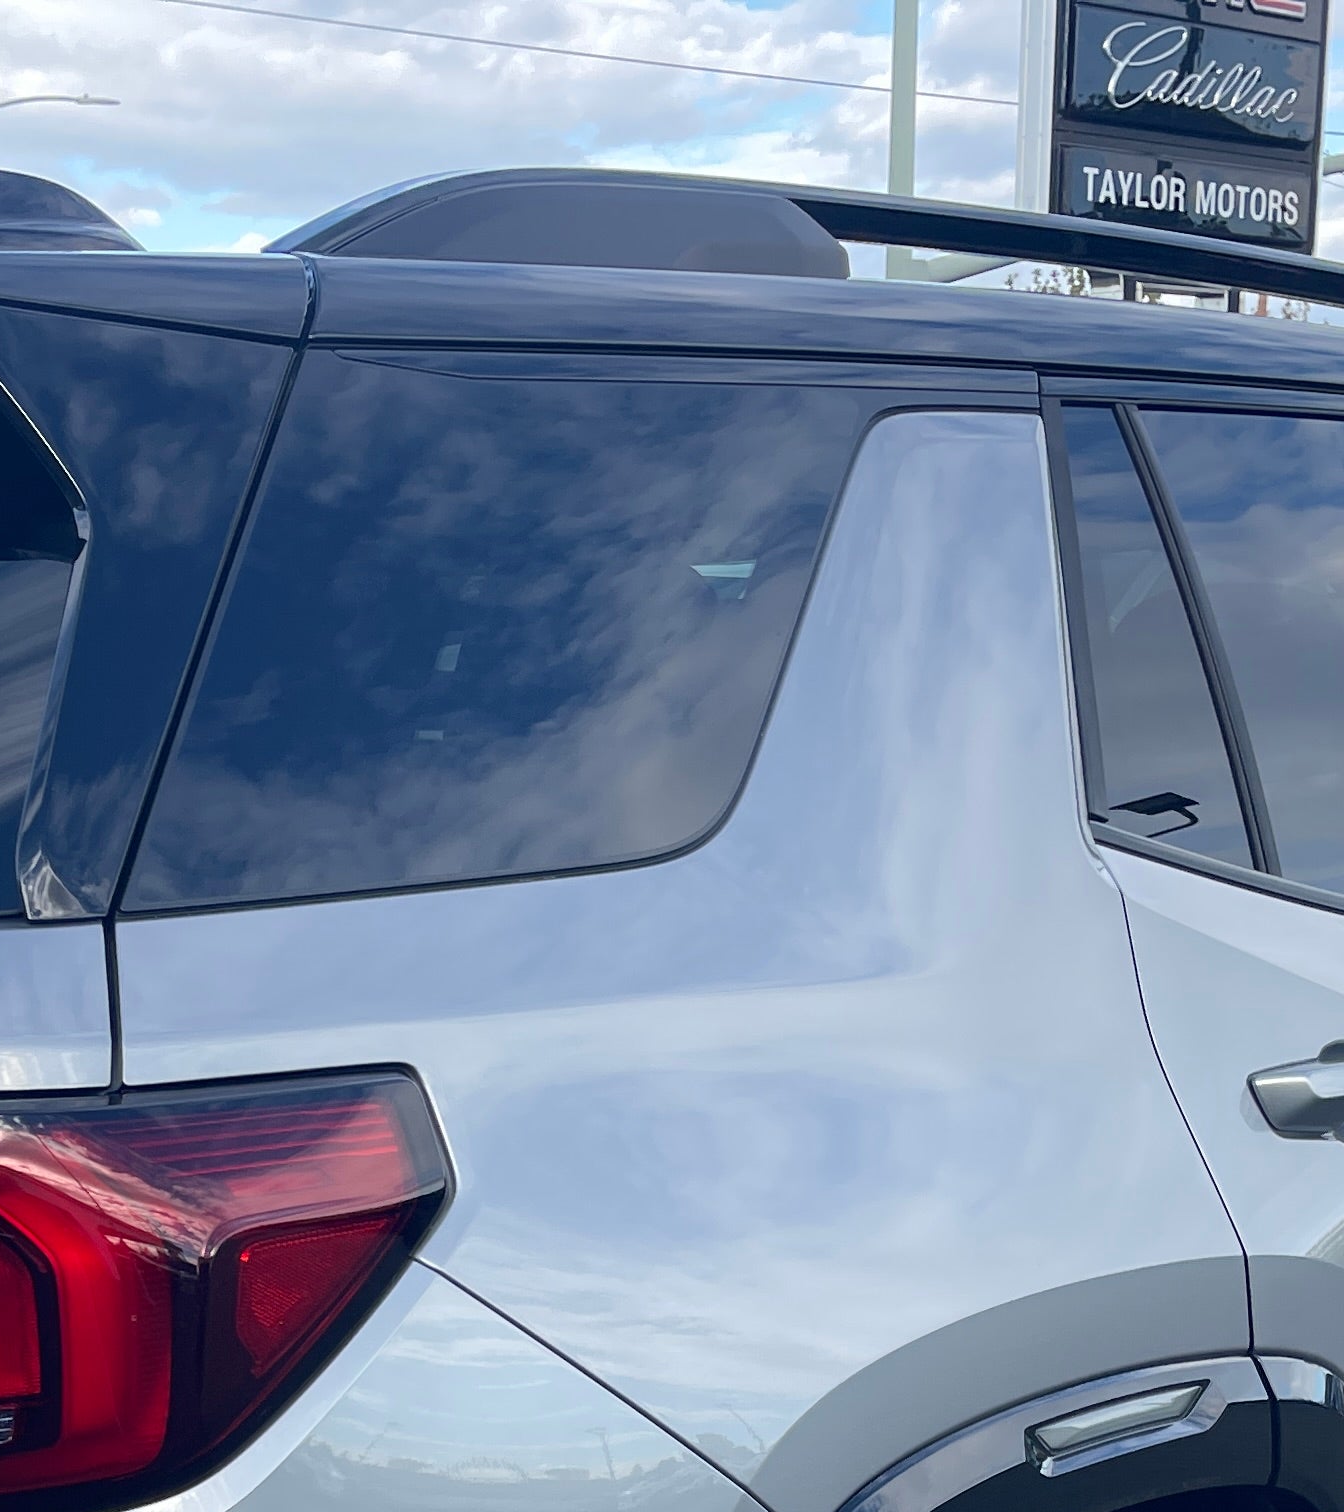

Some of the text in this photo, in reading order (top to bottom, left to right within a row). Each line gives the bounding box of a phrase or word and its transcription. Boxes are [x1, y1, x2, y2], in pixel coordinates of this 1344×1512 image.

[1102, 21, 1299, 123] Cadillac
[1082, 166, 1300, 226] TAYLOR MOTORS
